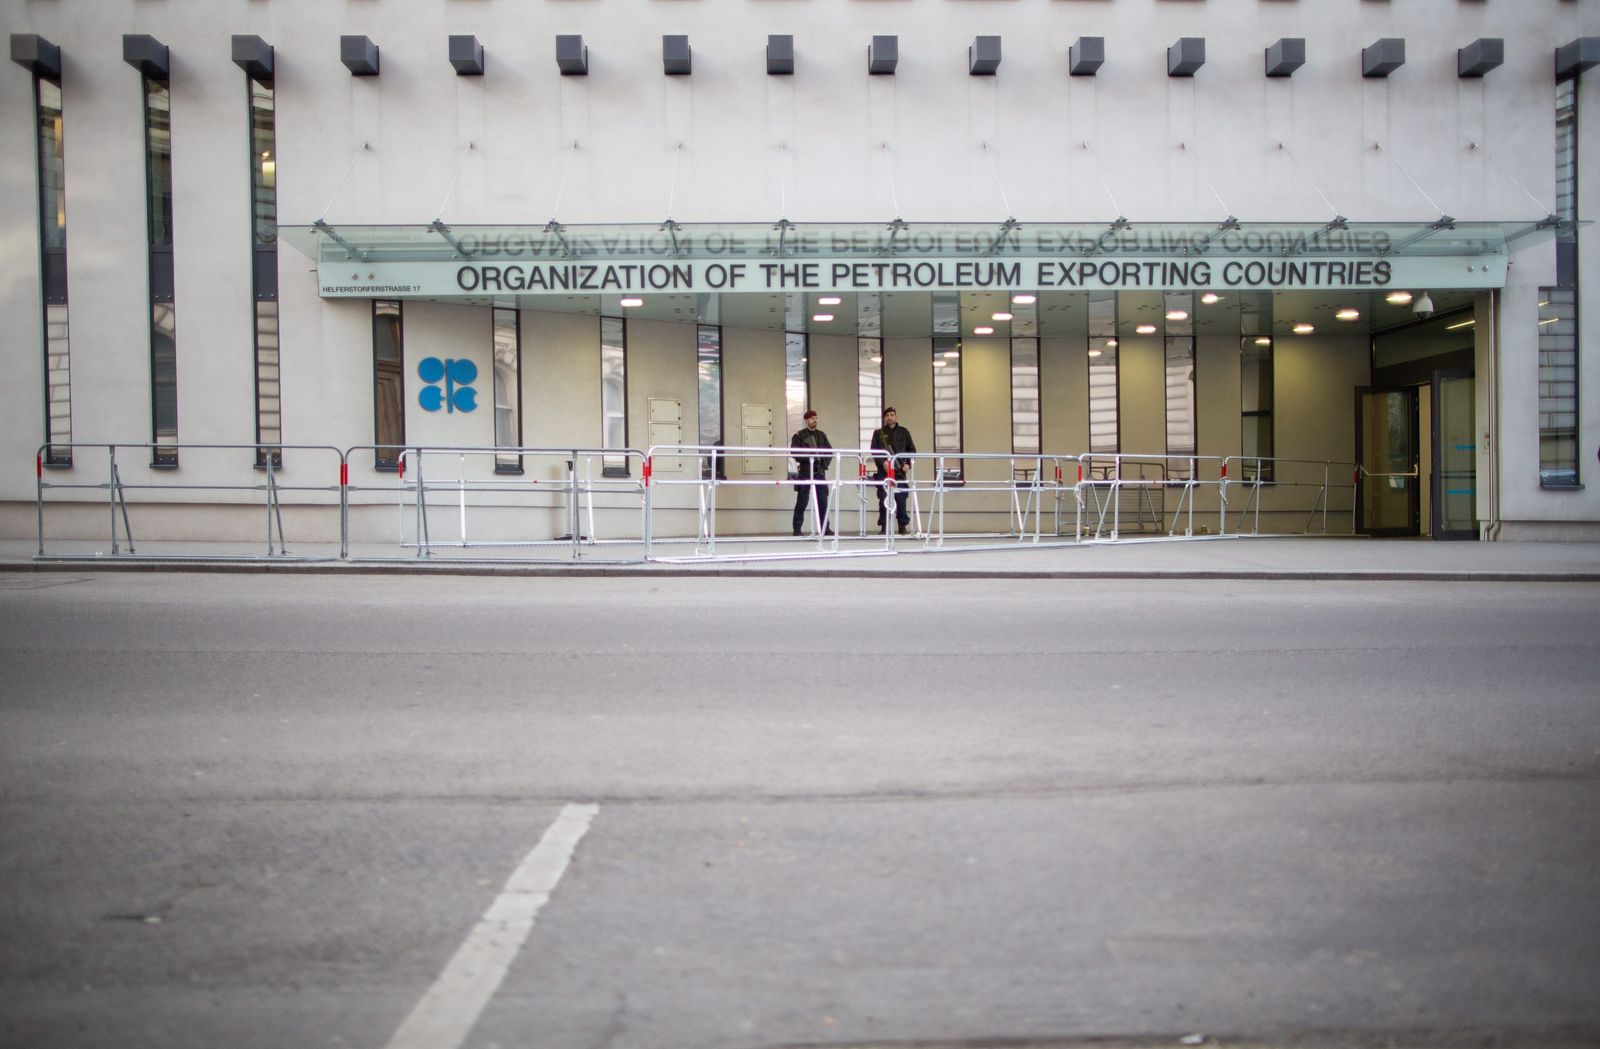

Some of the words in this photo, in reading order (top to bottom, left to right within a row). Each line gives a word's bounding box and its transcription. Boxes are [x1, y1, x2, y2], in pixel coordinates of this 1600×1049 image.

[456, 264, 693, 291] ORGANIZATION
[704, 263, 747, 289] OF
[758, 262, 820, 288] THE
[831, 262, 1022, 288] PETROLEUM
[1037, 261, 1212, 287] EXPORTING
[1222, 260, 1392, 286] COUNTRIES
[322, 285, 412, 293] HELFERSTORFERSTRASSE
